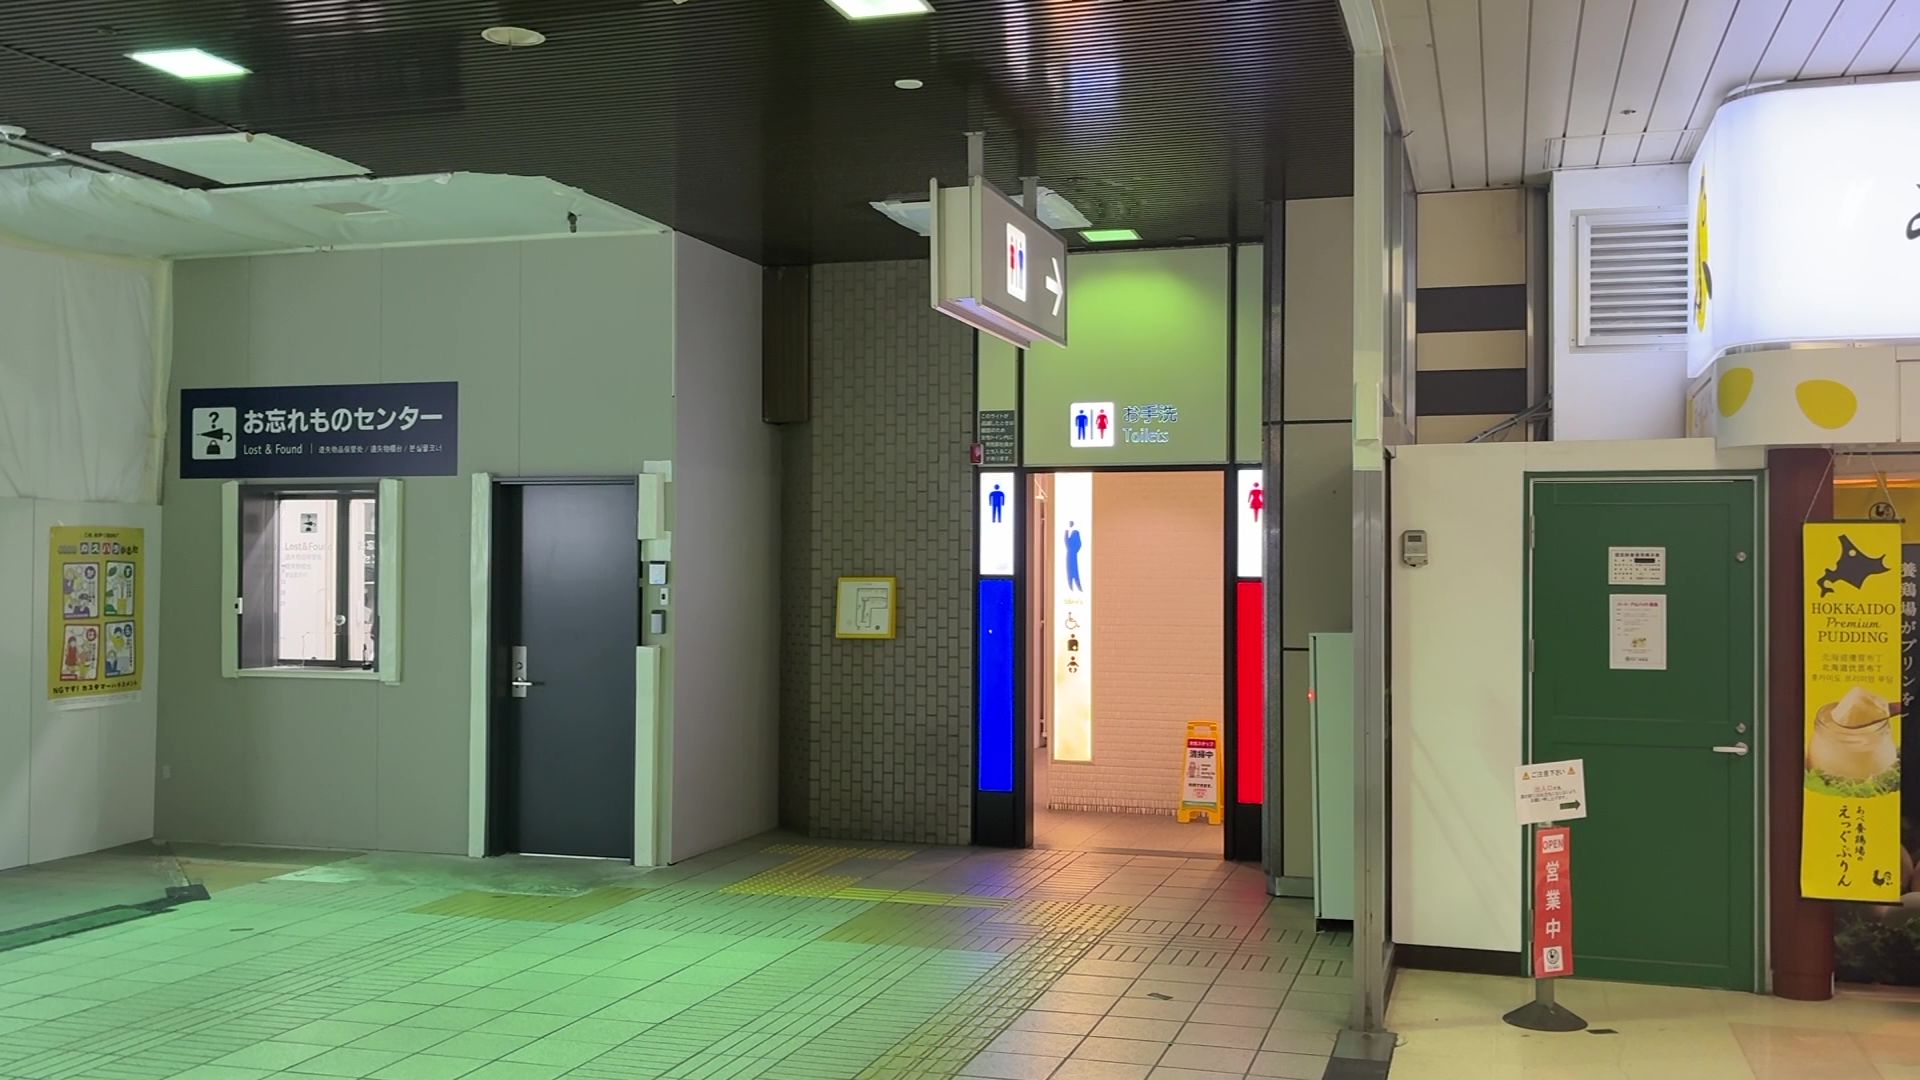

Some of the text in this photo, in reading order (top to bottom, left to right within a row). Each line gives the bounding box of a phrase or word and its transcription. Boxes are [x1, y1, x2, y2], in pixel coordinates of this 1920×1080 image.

[243, 405, 443, 434] お忘れものセンター
[1122, 404, 1178, 423] お手洗
[1122, 428, 1169, 443] Toilets
[243, 444, 262, 455] Lost
[264, 444, 273, 455] &
[275, 443, 303, 455] Found
[1812, 602, 1896, 616] HOKKAIDO
[1826, 617, 1881, 629] Premium
[1818, 630, 1889, 643] PUDDING
[1543, 838, 1564, 850] OPEN
[1545, 860, 1561, 939] 営業中
